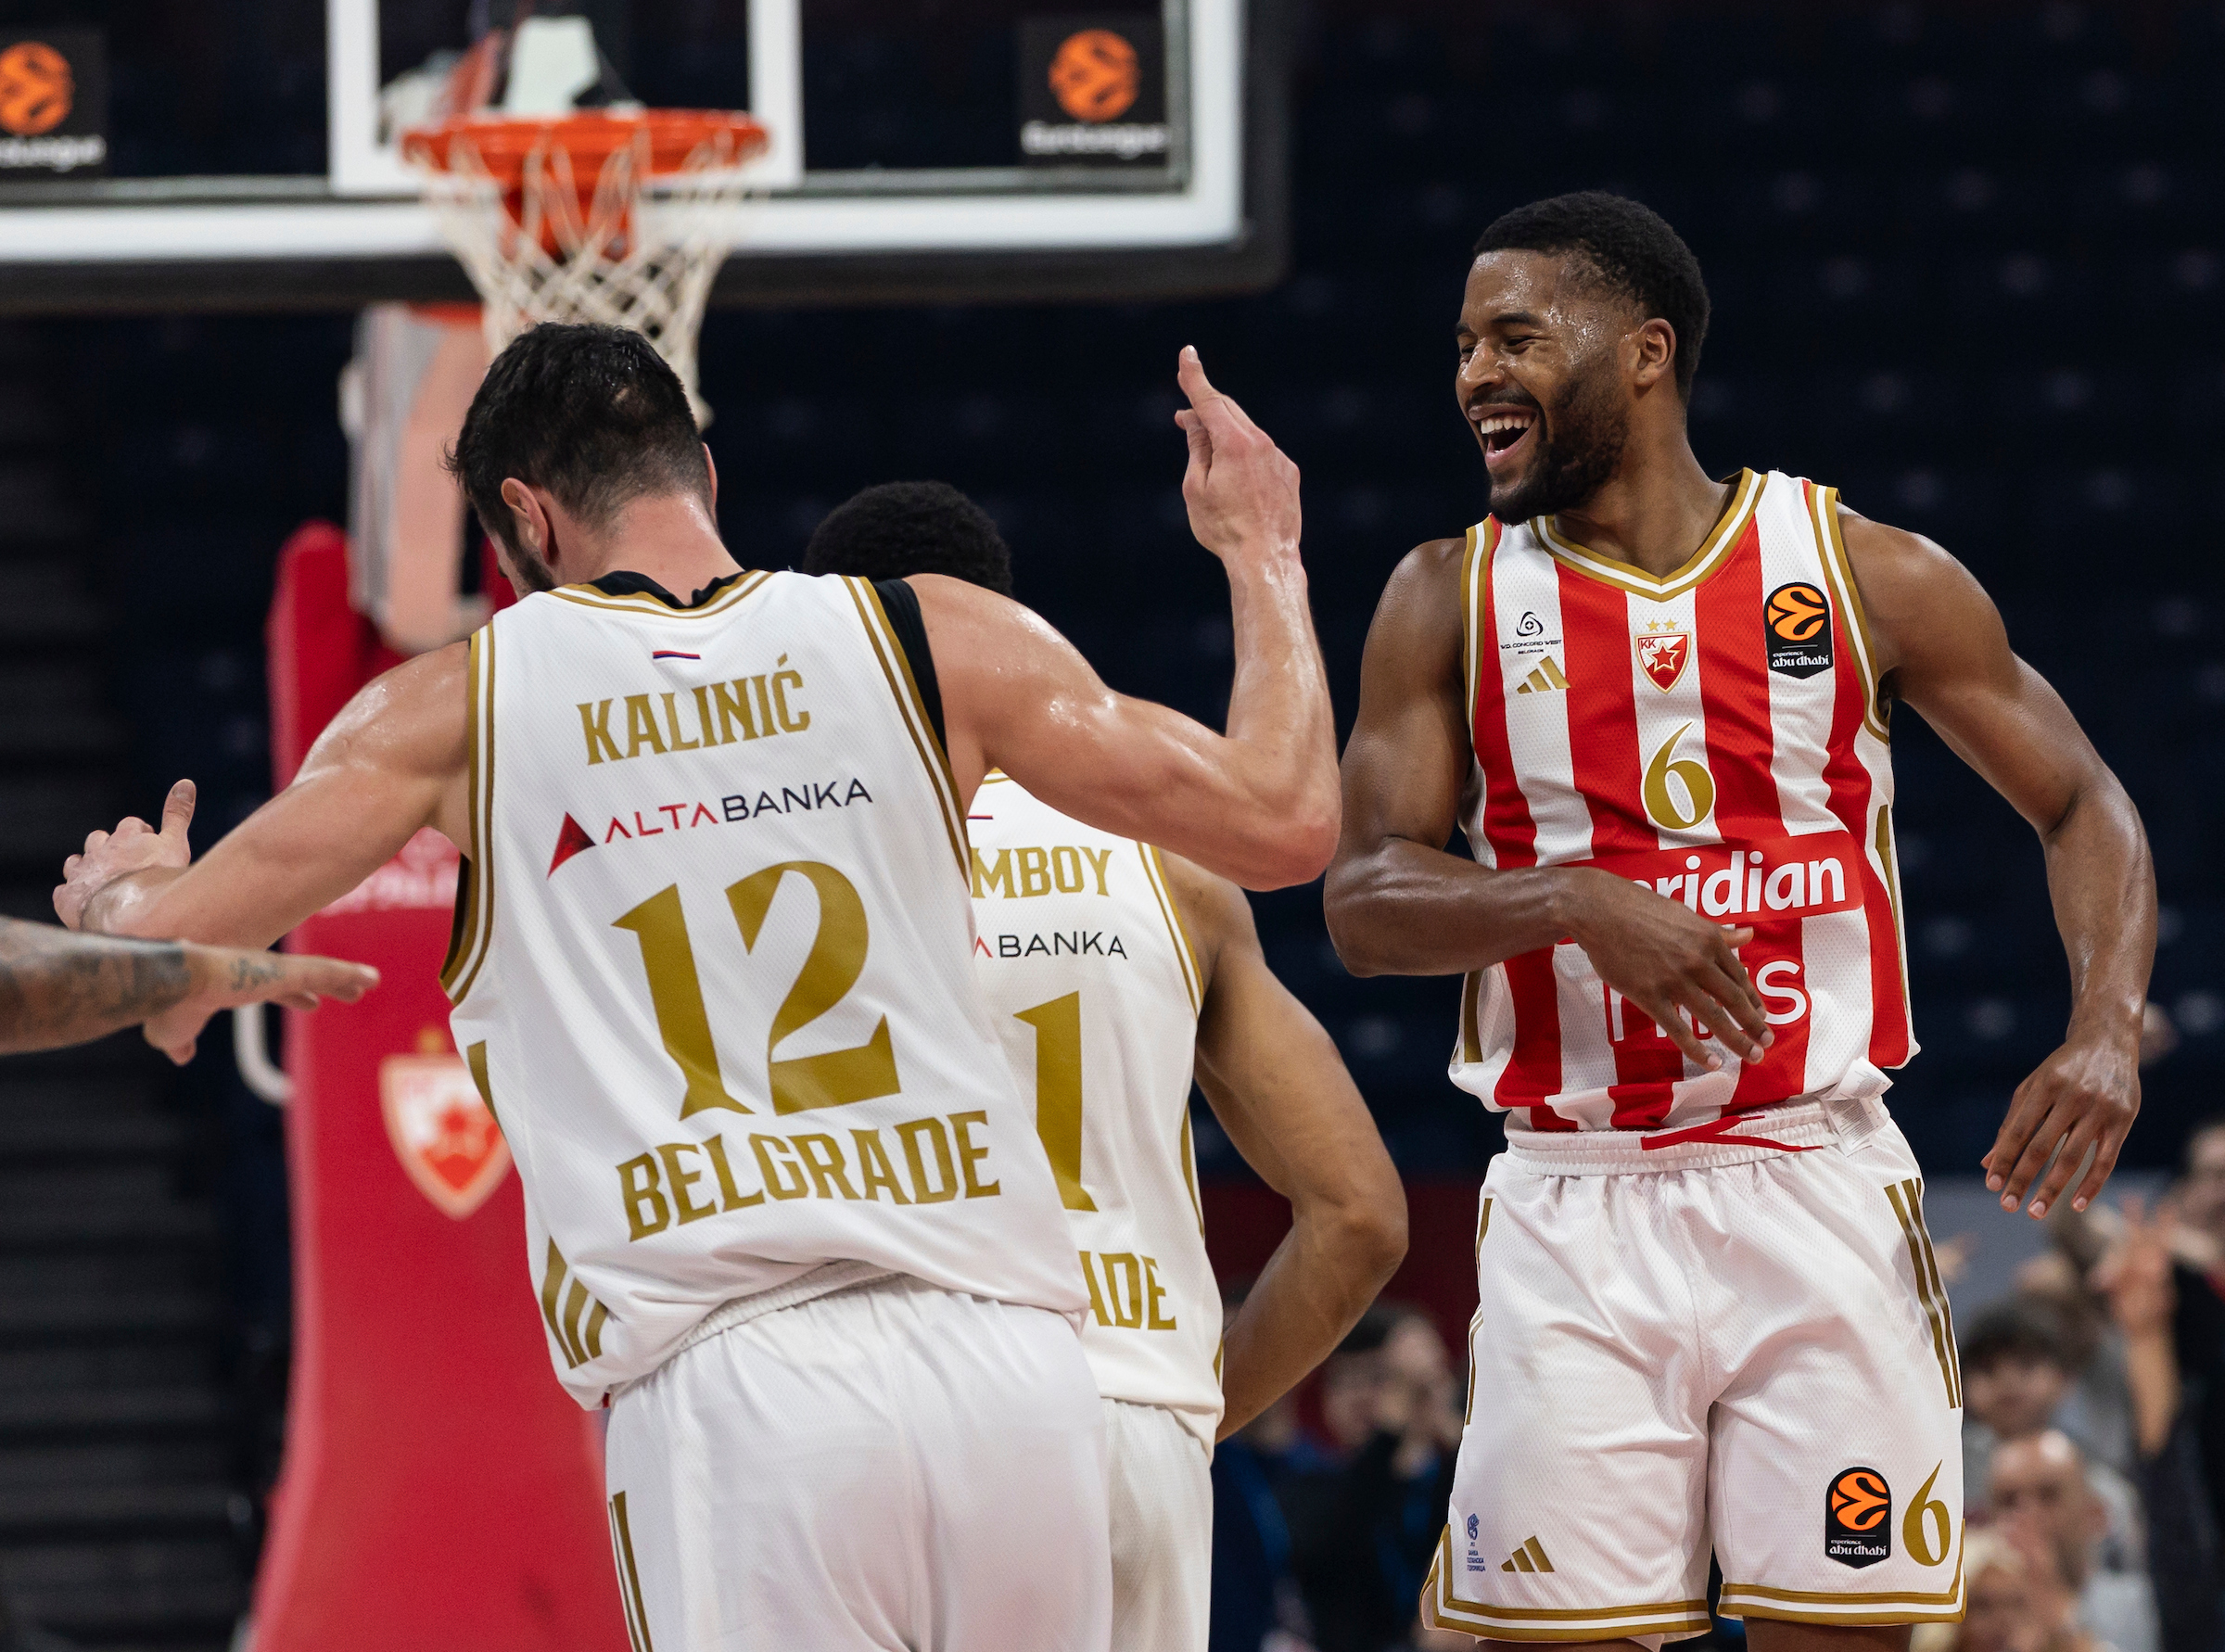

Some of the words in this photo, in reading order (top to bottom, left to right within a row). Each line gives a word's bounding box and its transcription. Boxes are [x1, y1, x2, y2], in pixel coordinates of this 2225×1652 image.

[1639, 639, 1657, 650] KK
[1772, 657, 1795, 667] abu
[1796, 654, 1829, 666] dhabi
[576, 652, 810, 766] KALINIĆ
[1642, 721, 1716, 831] 6
[1634, 850, 1846, 917] ridian
[610, 860, 901, 1122] 12
[1012, 990, 1099, 1213] 1
[615, 1110, 1001, 1243] BELGRADE
[1829, 1544, 1852, 1555] abu
[1853, 1544, 1888, 1556] dhabi
[1902, 1458, 1952, 1567] 6
